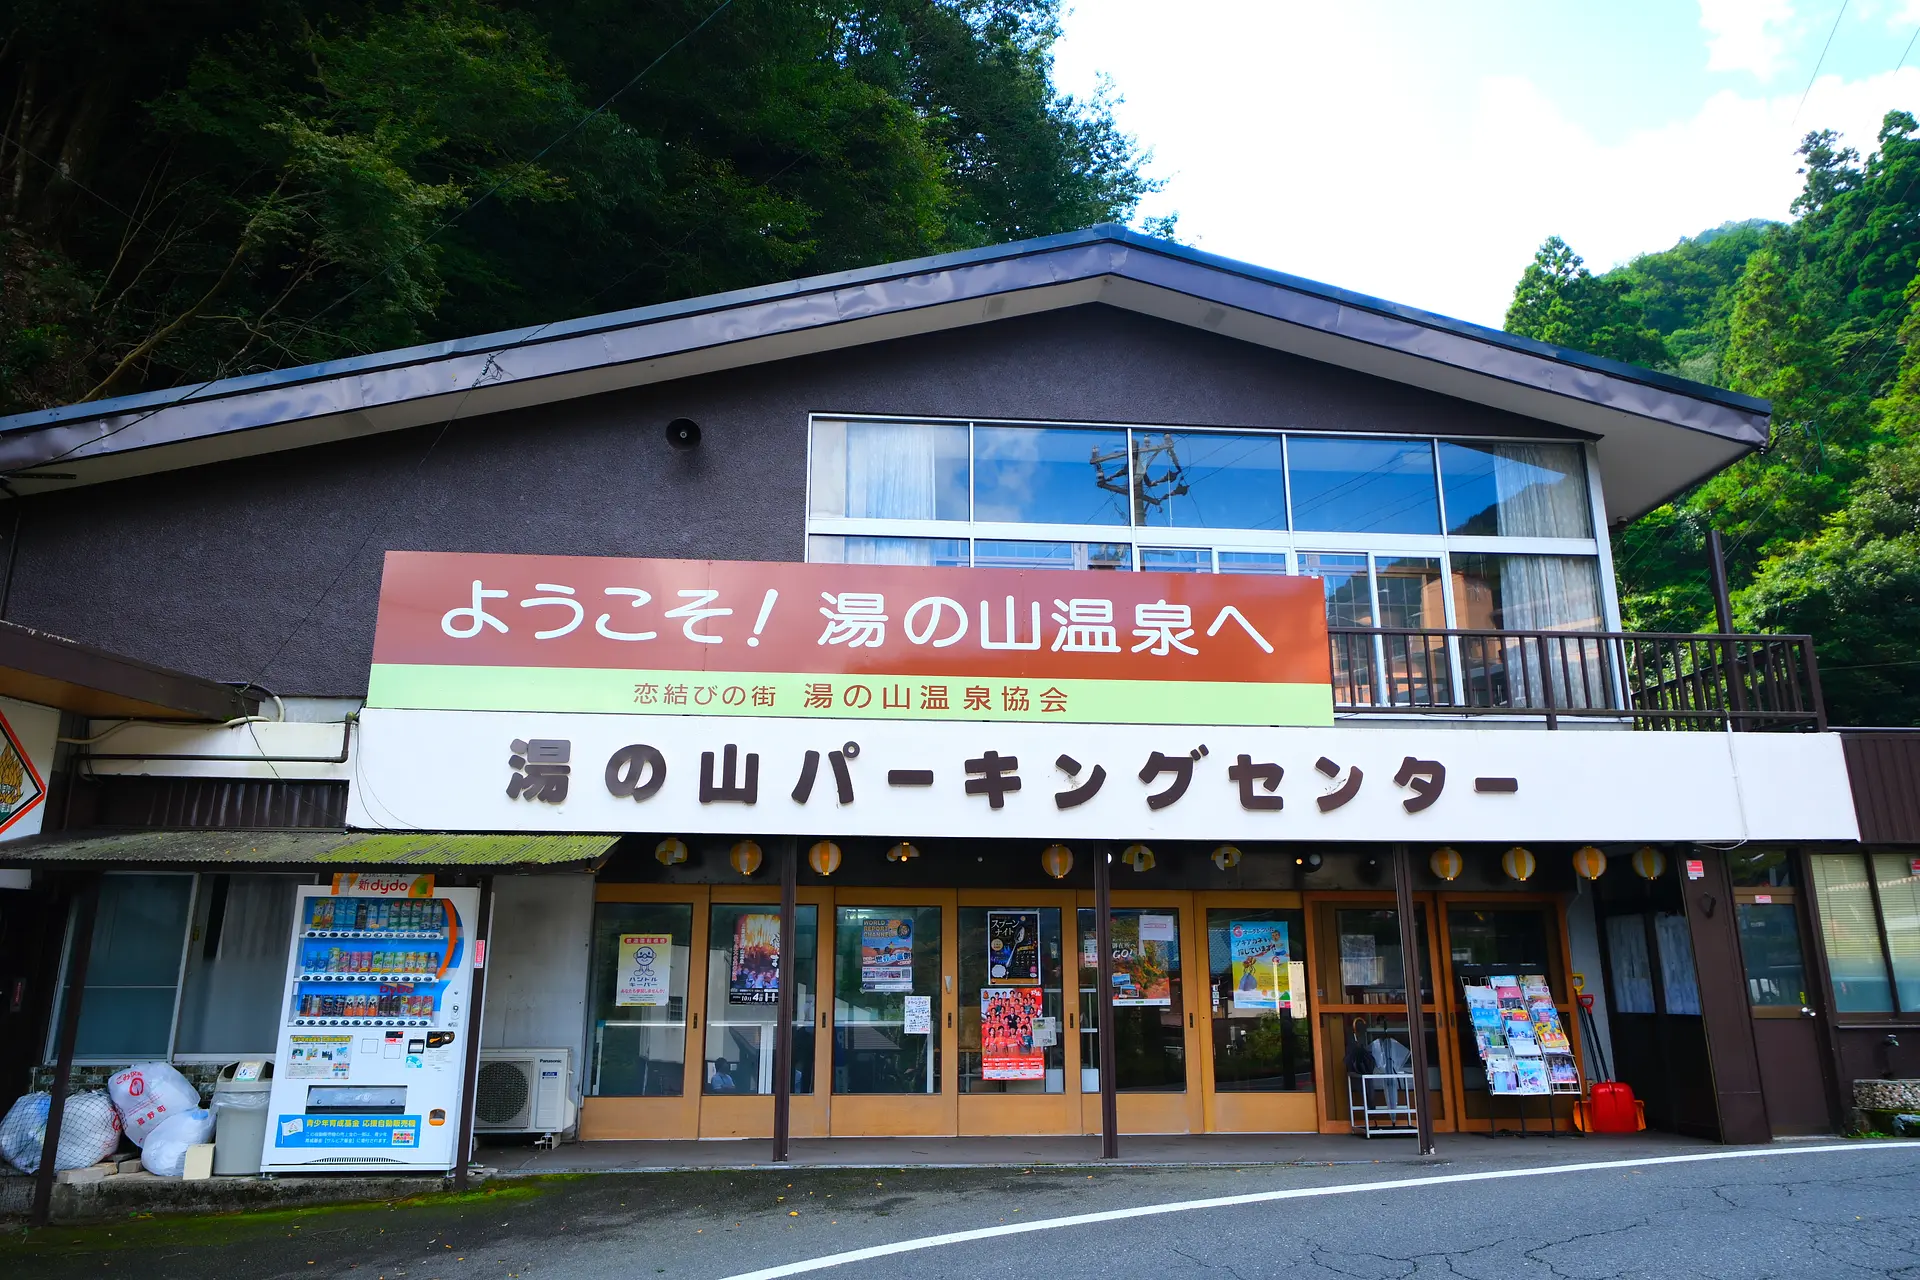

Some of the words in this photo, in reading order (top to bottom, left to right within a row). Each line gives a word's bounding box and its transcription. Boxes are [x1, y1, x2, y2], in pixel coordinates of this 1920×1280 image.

[441, 580, 779, 647] ようこそ!
[817, 592, 1275, 656] 湯の山温泉へ
[633, 683, 776, 708] 恋結びの街
[803, 682, 1069, 713] 湯の山温泉協会
[506, 737, 1519, 815] 湯の山パーキングセンター
